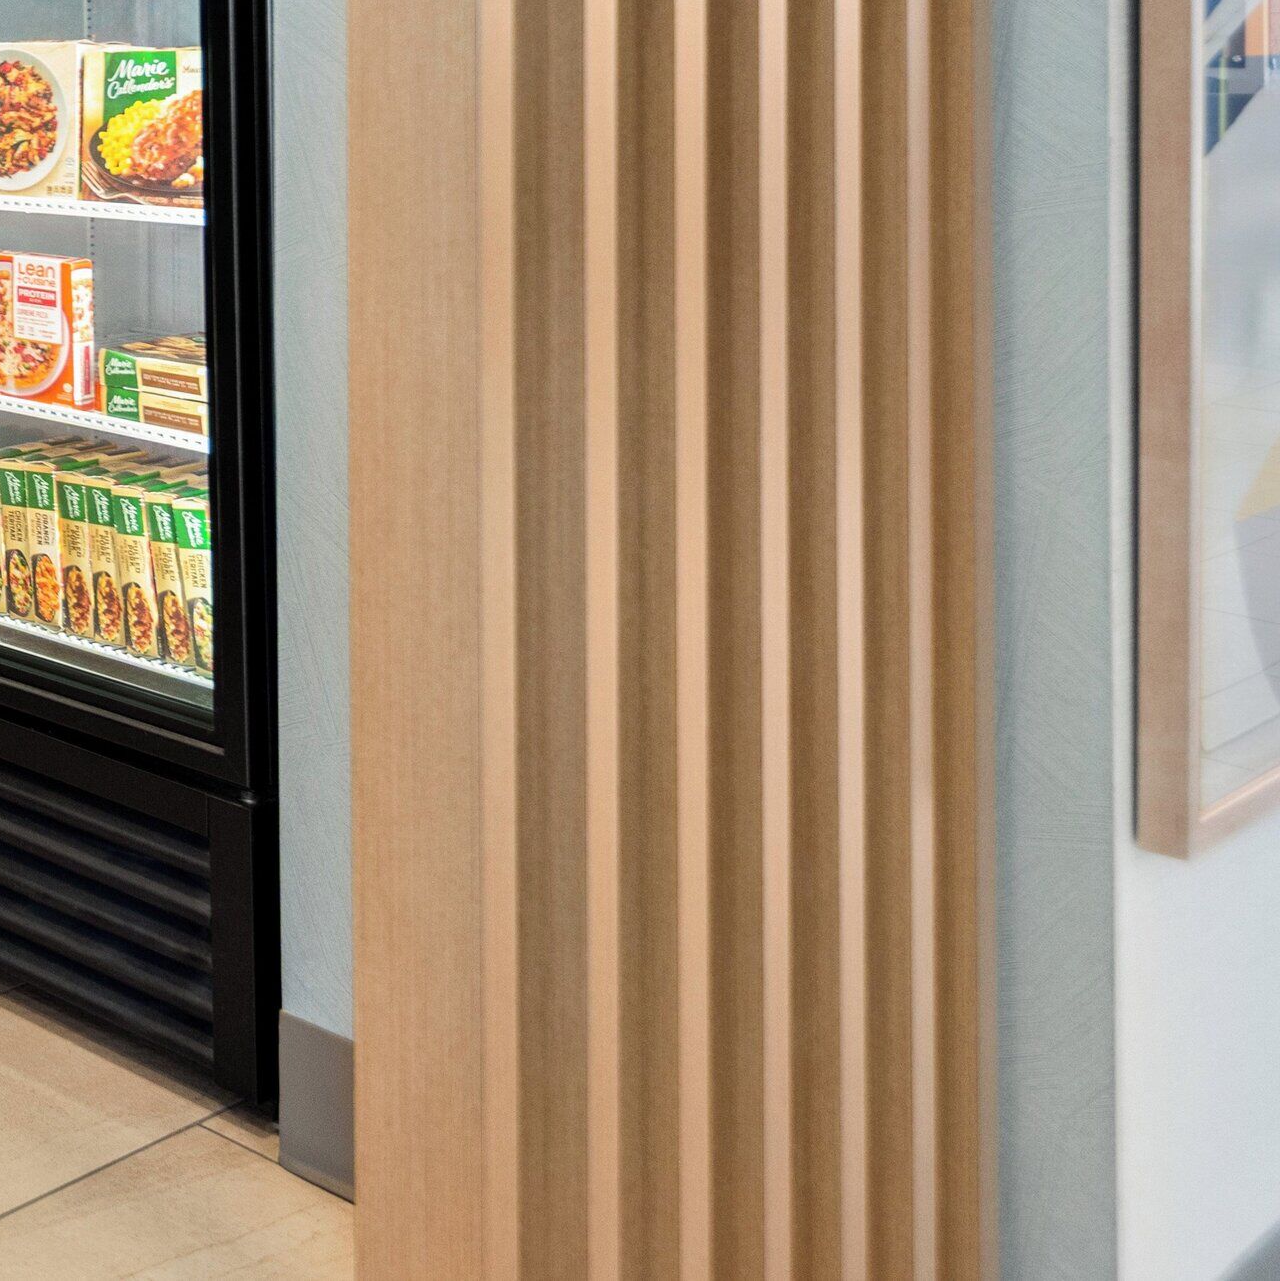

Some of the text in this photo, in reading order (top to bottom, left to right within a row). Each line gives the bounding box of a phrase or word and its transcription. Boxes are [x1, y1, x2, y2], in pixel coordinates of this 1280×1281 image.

[112, 59, 170, 79] Marie
[107, 76, 176, 99] Callender's
[18, 262, 55, 278] Lean
